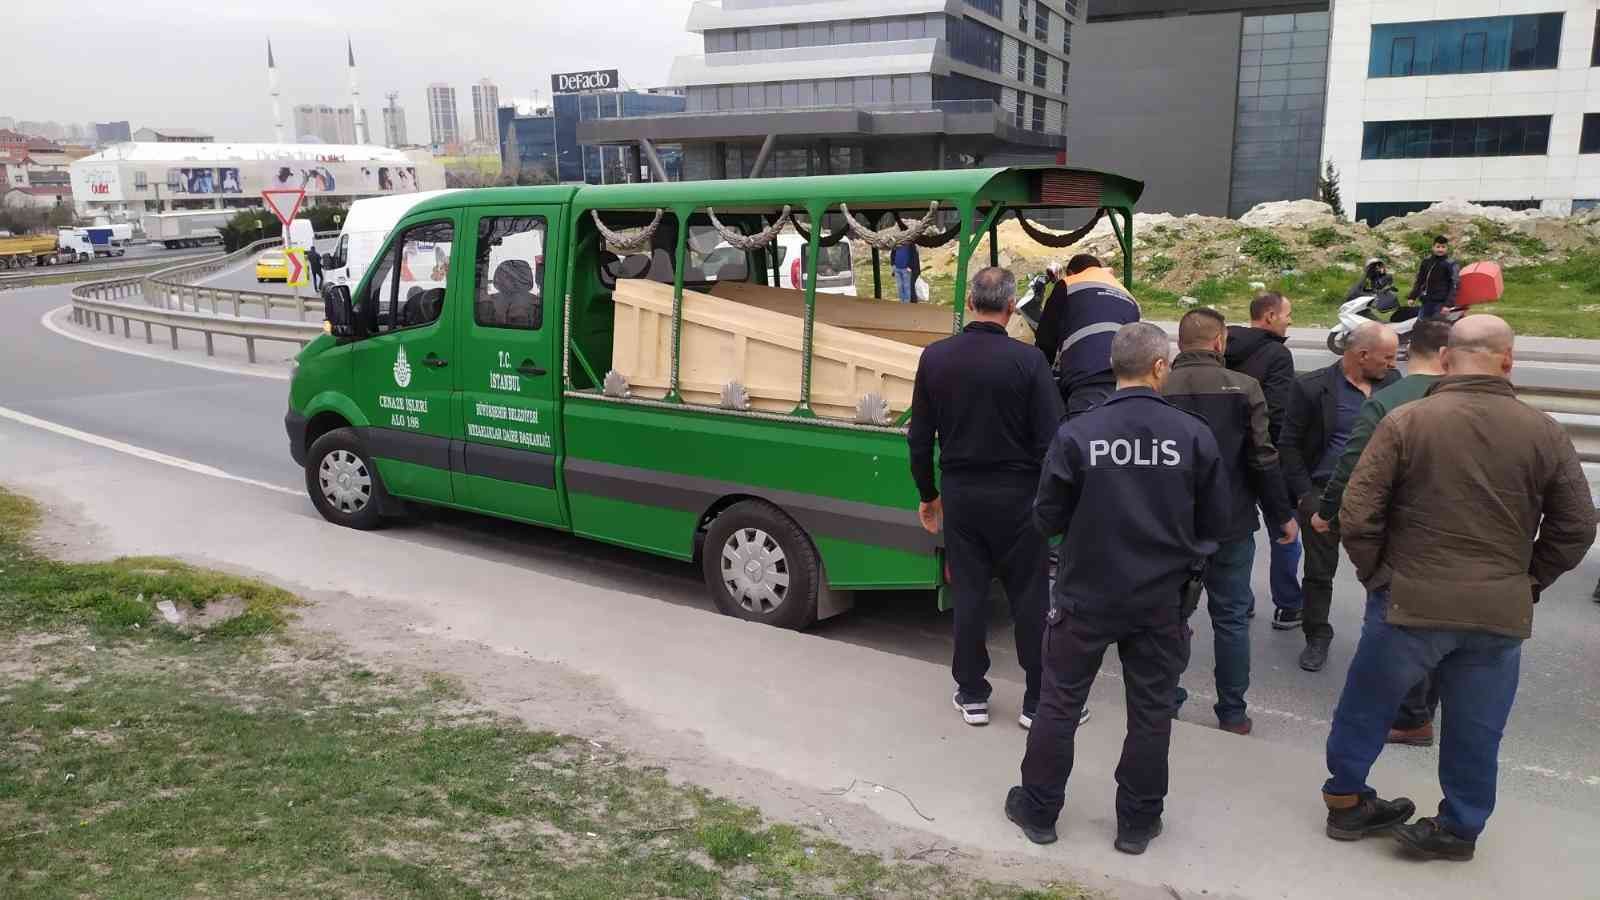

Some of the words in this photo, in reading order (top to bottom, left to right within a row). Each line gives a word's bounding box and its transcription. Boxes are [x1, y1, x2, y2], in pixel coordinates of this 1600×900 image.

[559, 71, 610, 90] DeFacto
[498, 351, 512, 368] T.C.
[379, 395, 405, 410] CENAZE
[391, 414, 405, 426] ALO
